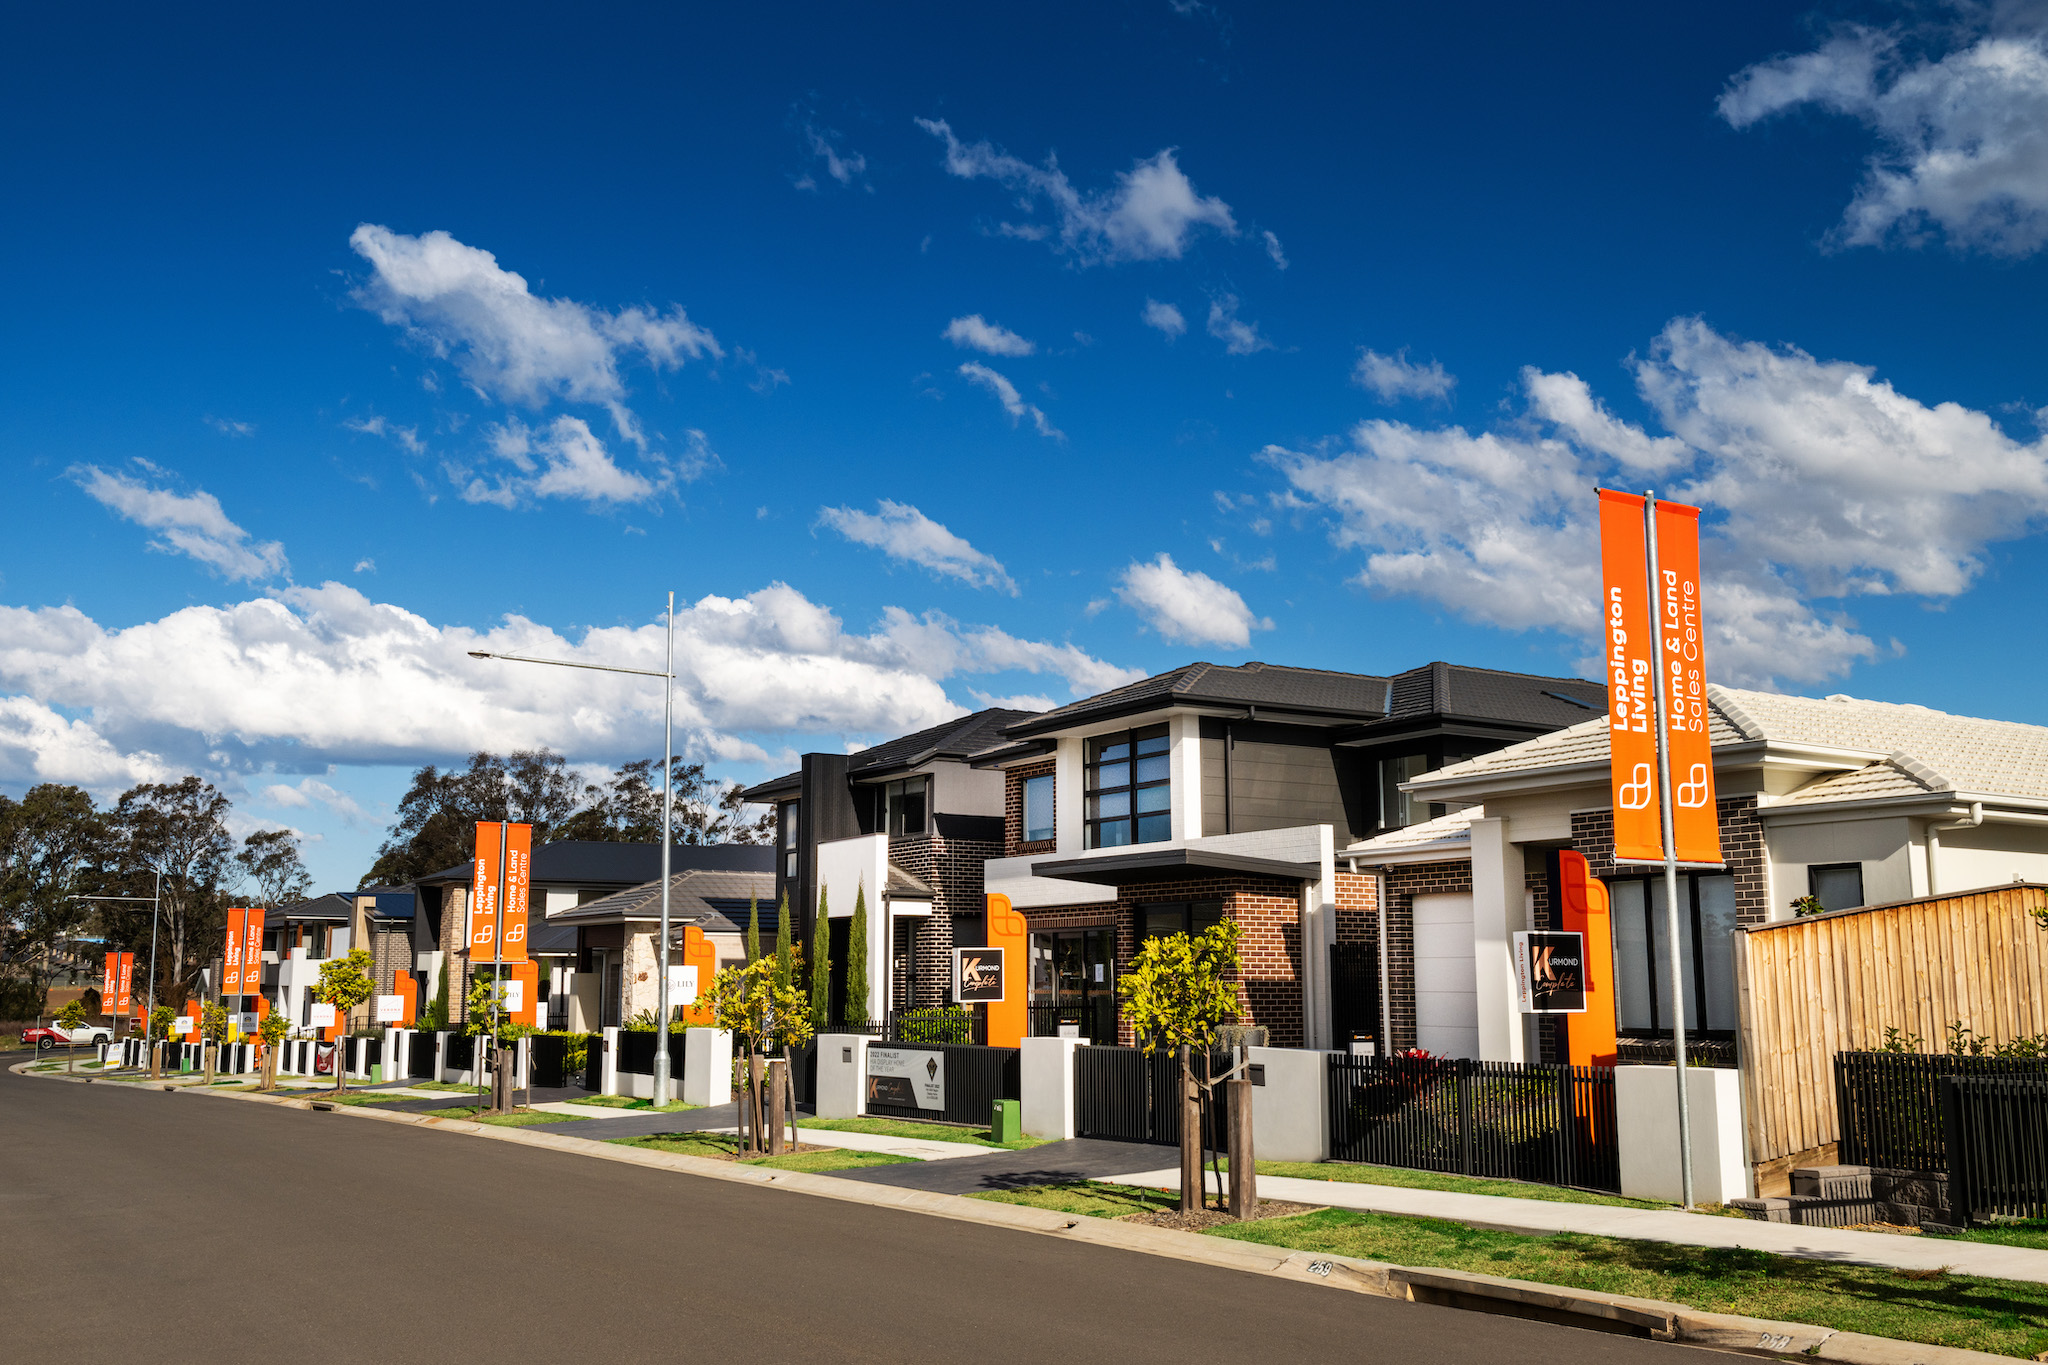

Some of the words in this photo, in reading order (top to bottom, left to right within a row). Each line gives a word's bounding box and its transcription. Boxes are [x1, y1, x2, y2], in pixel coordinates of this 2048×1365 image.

[1663, 570, 1679, 629] Land
[1683, 580, 1699, 662] Centre
[1609, 586, 1628, 731] Leppington
[1666, 637, 1681, 653] &
[1631, 659, 1649, 733] Living
[1671, 662, 1686, 731] Home
[1686, 670, 1703, 733] Sales
[509, 849, 518, 874] Land
[517, 853, 528, 886] Centre
[474, 859, 487, 914] Leppington
[484, 885, 497, 915] Living
[507, 885, 517, 913] Home
[516, 887, 526, 913] Sales
[225, 930, 235, 966] Leppington
[254, 926, 262, 947] Centre
[232, 947, 241, 966] Living
[962, 957, 1000, 982] KURMOND
[1532, 946, 1579, 981] KURMOND
[963, 974, 997, 992] Complete
[1535, 972, 1576, 996] Complete
[1306, 1260, 1333, 1277] 259
[1755, 1332, 1791, 1350] 258
